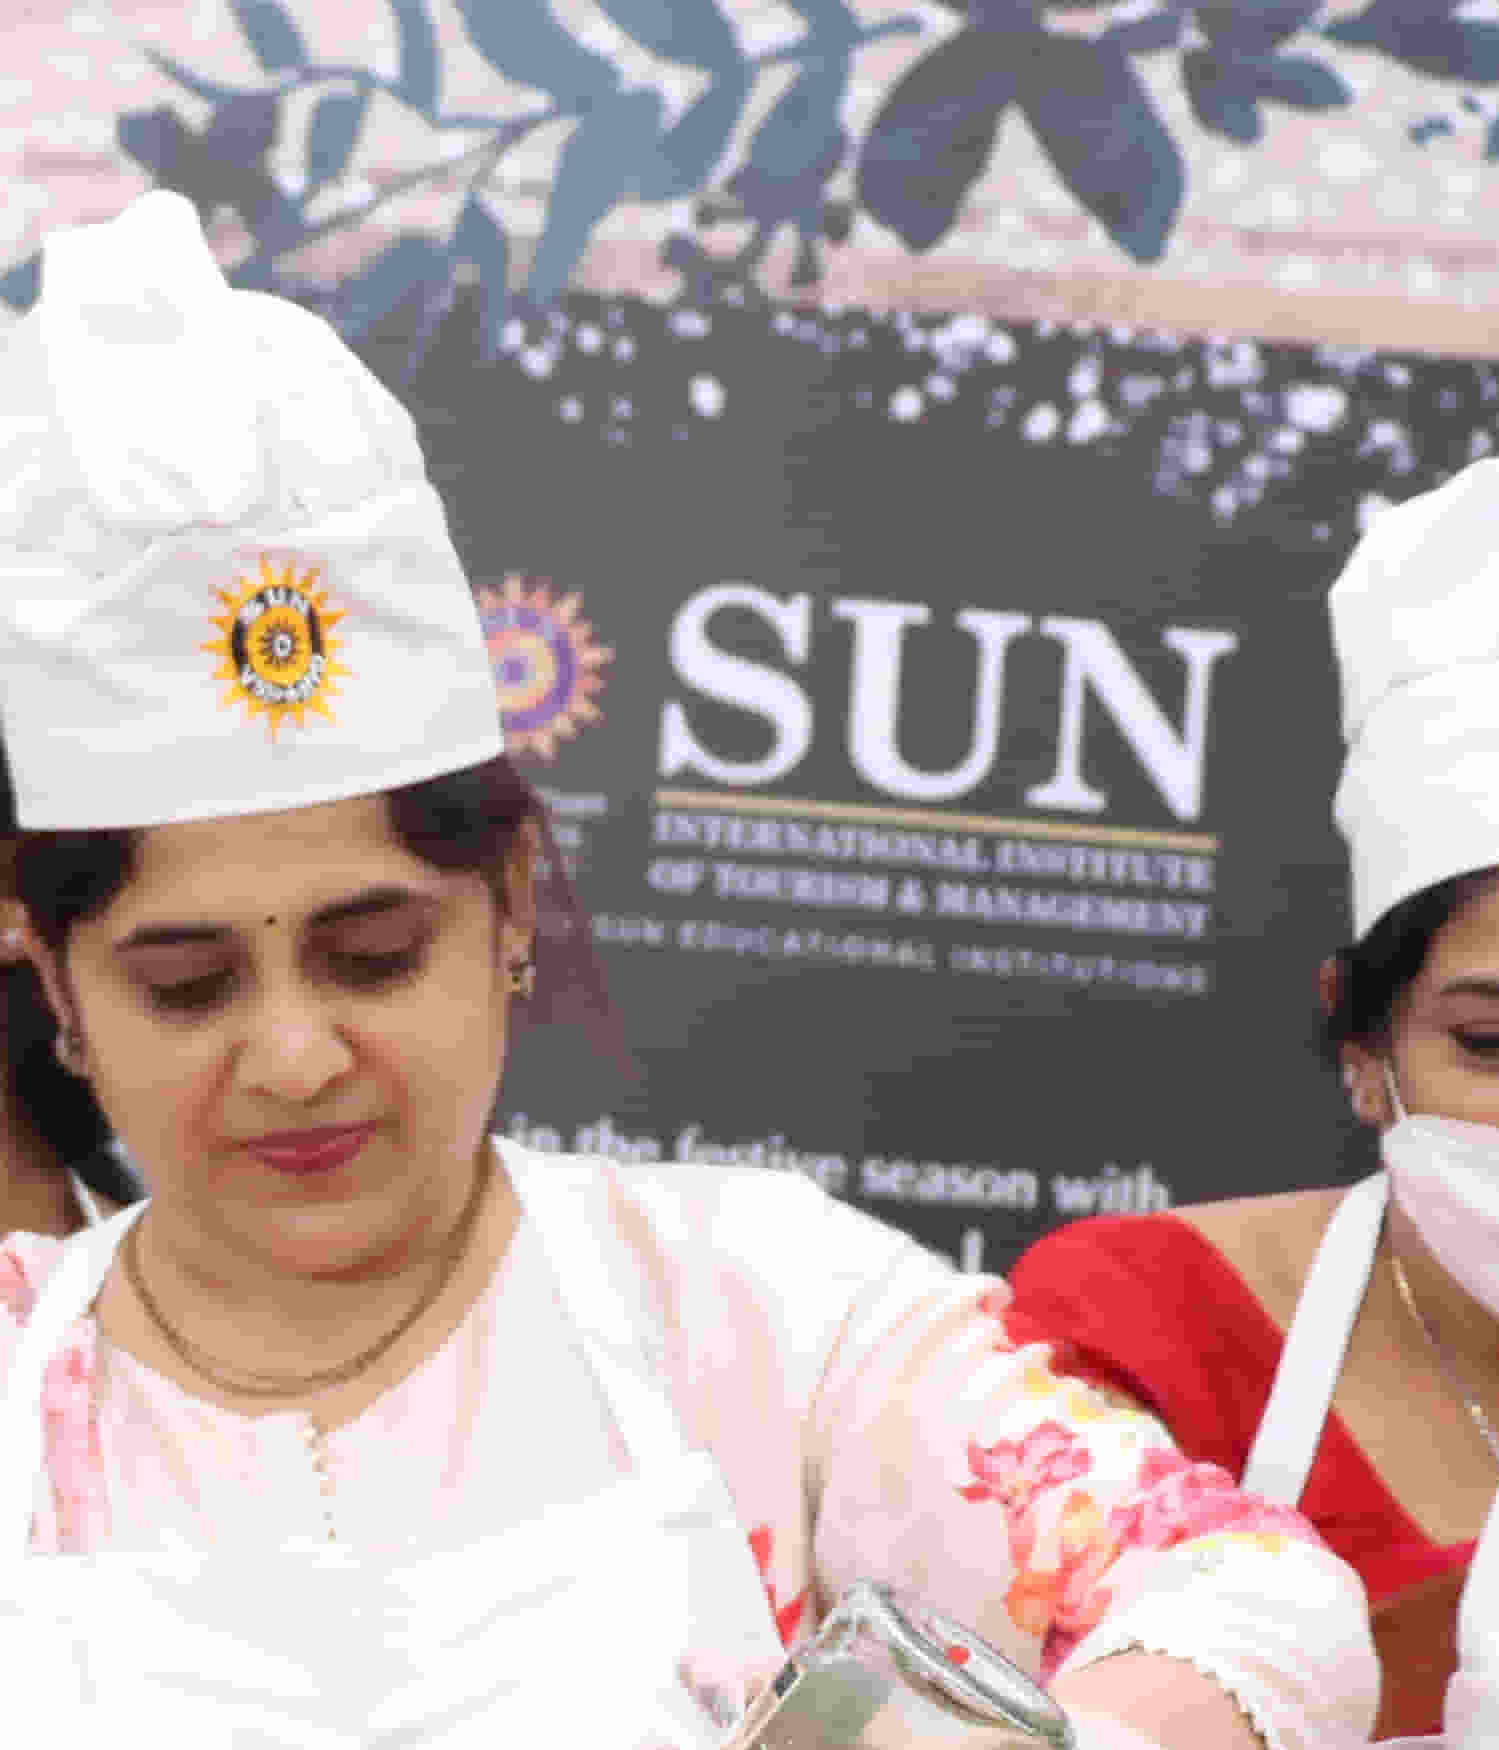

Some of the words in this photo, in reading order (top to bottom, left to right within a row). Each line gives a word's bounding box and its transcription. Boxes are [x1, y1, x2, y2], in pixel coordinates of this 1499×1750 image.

[658, 582, 1238, 822] SUN
[653, 813, 988, 874] INTERNATIONAL
[996, 840, 1216, 892] INSTITUTE
[648, 861, 703, 892] OF
[713, 863, 890, 910] TOURISM
[896, 877, 927, 914] &
[935, 882, 1211, 938] MANAGEMENT
[594, 915, 665, 943] SUN
[677, 921, 936, 970] EDUCATIONAL
[948, 946, 1208, 993] INSTITUTIONS
[574, 1115, 662, 1164] the
[675, 1121, 850, 1200] festive
[860, 1158, 1038, 1208] season
[1050, 1162, 1170, 1213] with
